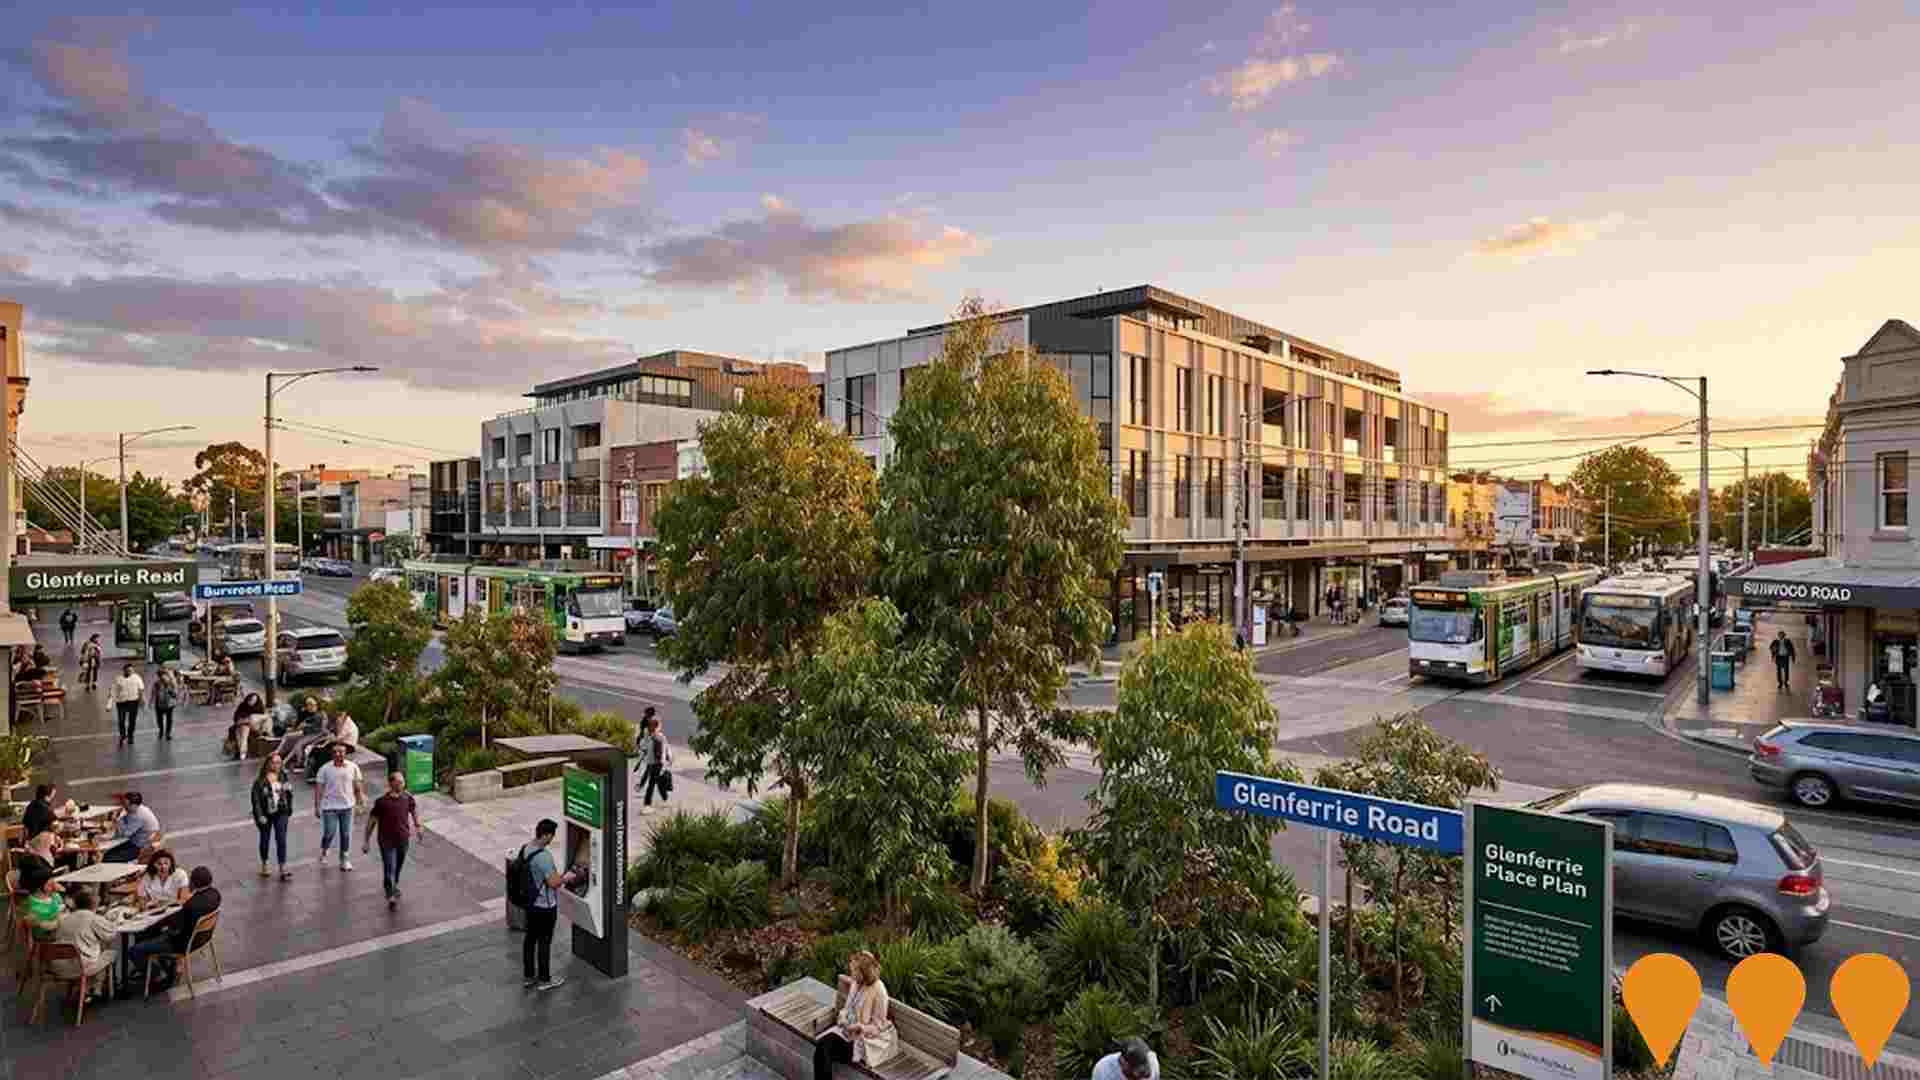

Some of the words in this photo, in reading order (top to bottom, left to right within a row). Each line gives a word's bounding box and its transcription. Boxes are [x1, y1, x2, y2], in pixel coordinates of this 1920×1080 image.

[1811, 586, 1852, 601] ROAD
[1233, 782, 1359, 826] Glenferrie
[1368, 805, 1439, 841] Road
[1485, 843, 1584, 877] Glenferrie
[1485, 863, 1537, 887] Place
[1543, 874, 1587, 898] Plan
